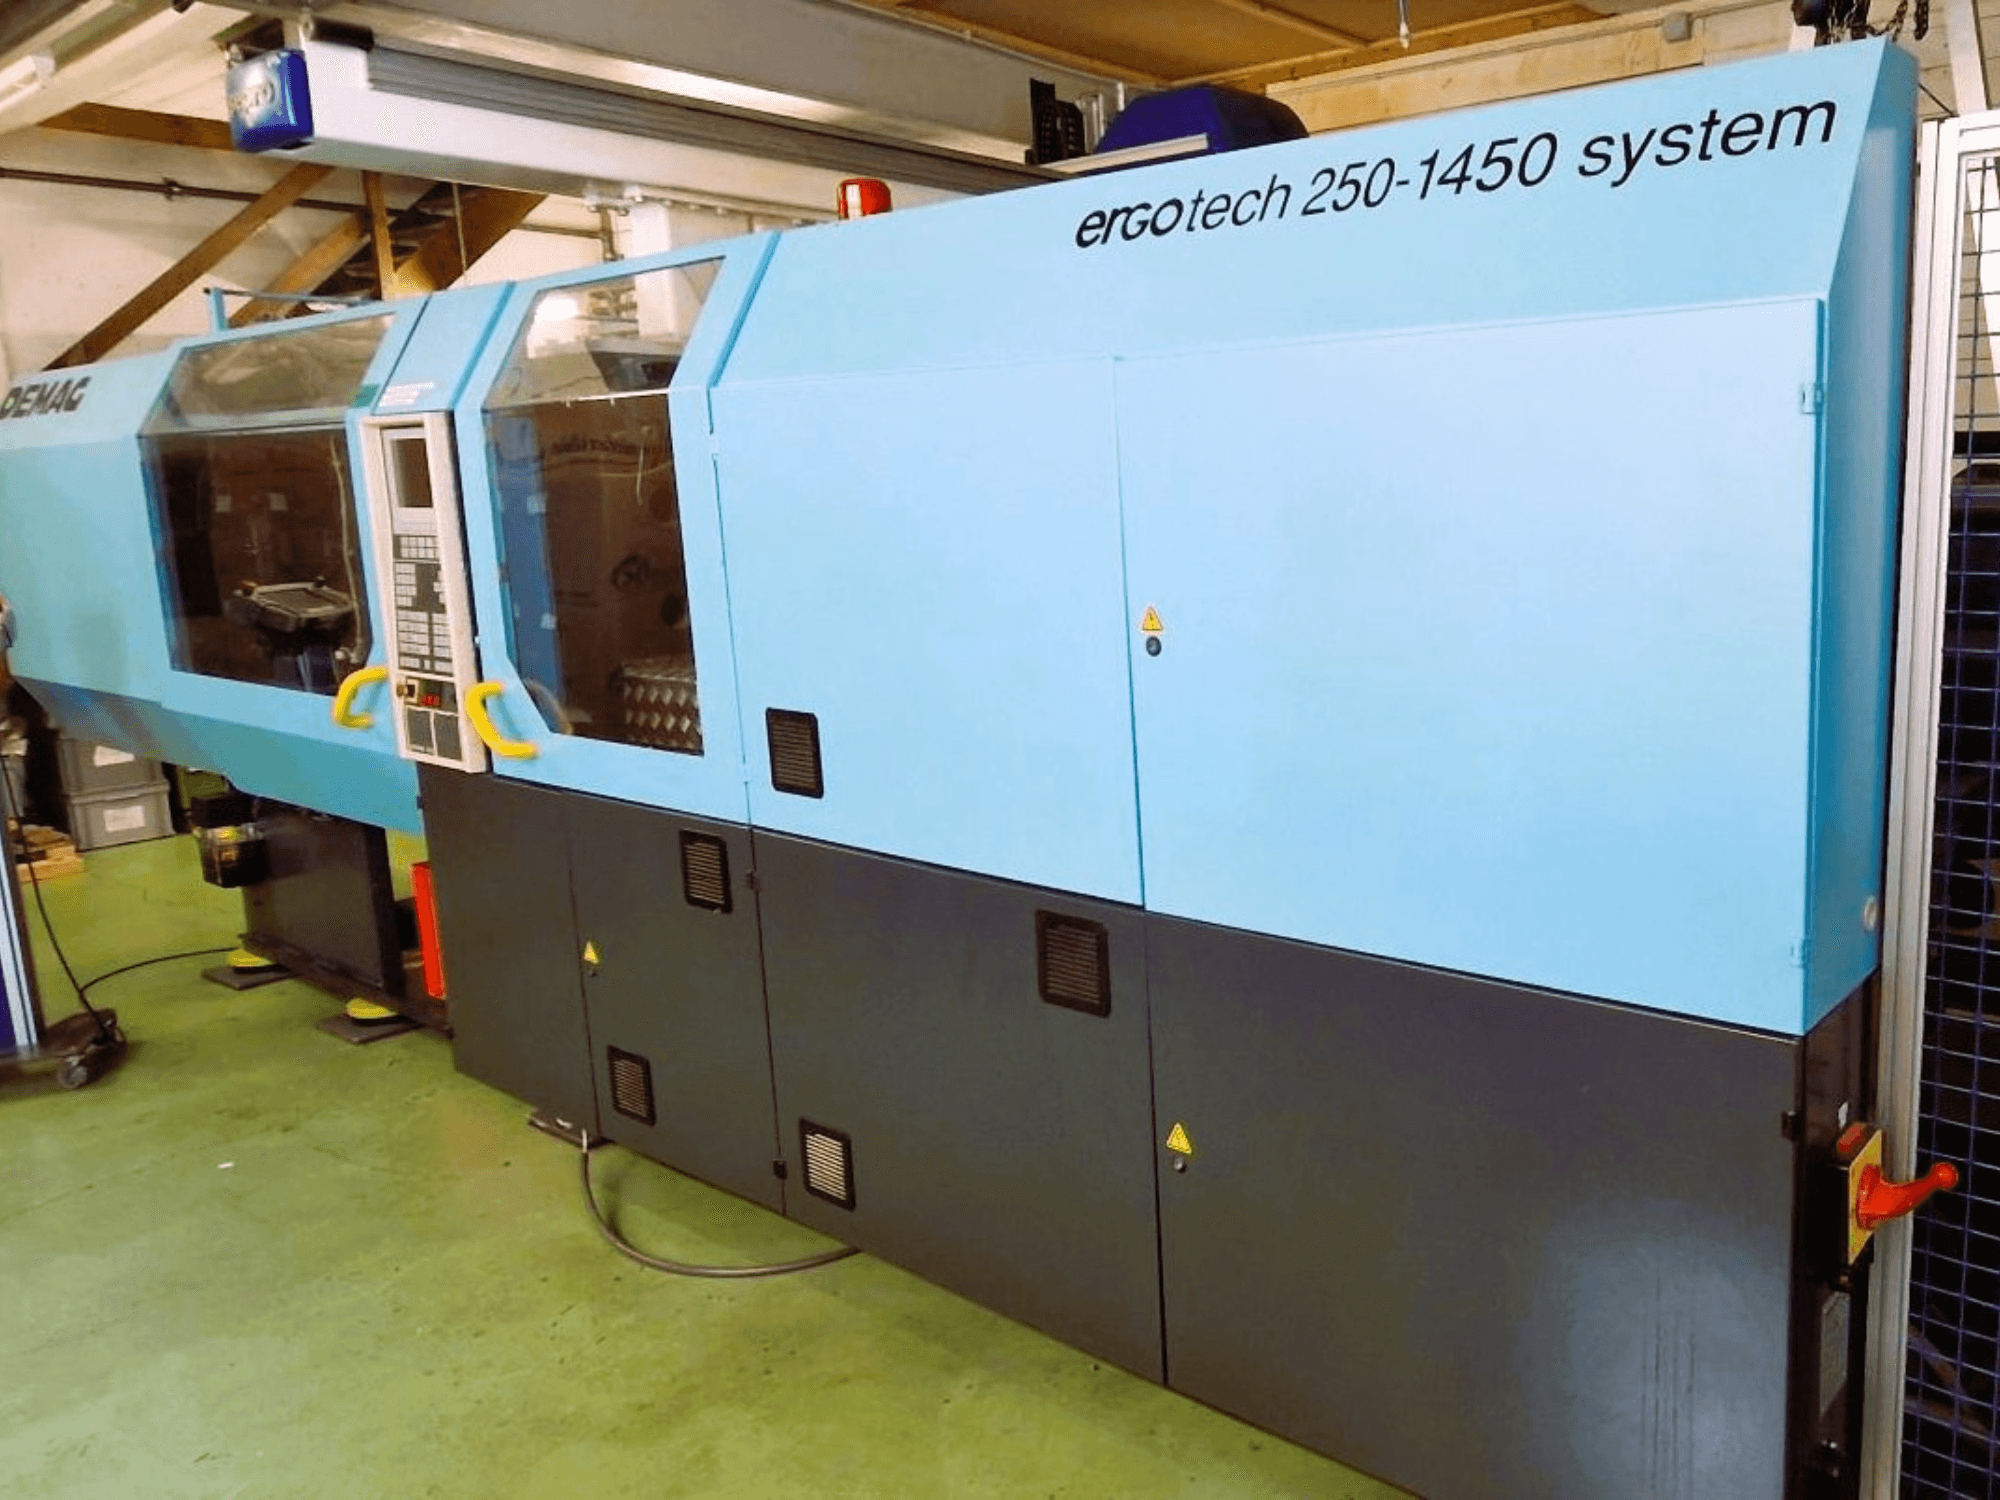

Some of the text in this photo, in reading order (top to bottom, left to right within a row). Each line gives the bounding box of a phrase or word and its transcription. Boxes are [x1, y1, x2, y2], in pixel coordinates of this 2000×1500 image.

[1301, 132, 1557, 216] 250-1450
[1578, 100, 1836, 188] system
[0, 376, 91, 420] DEMAG
